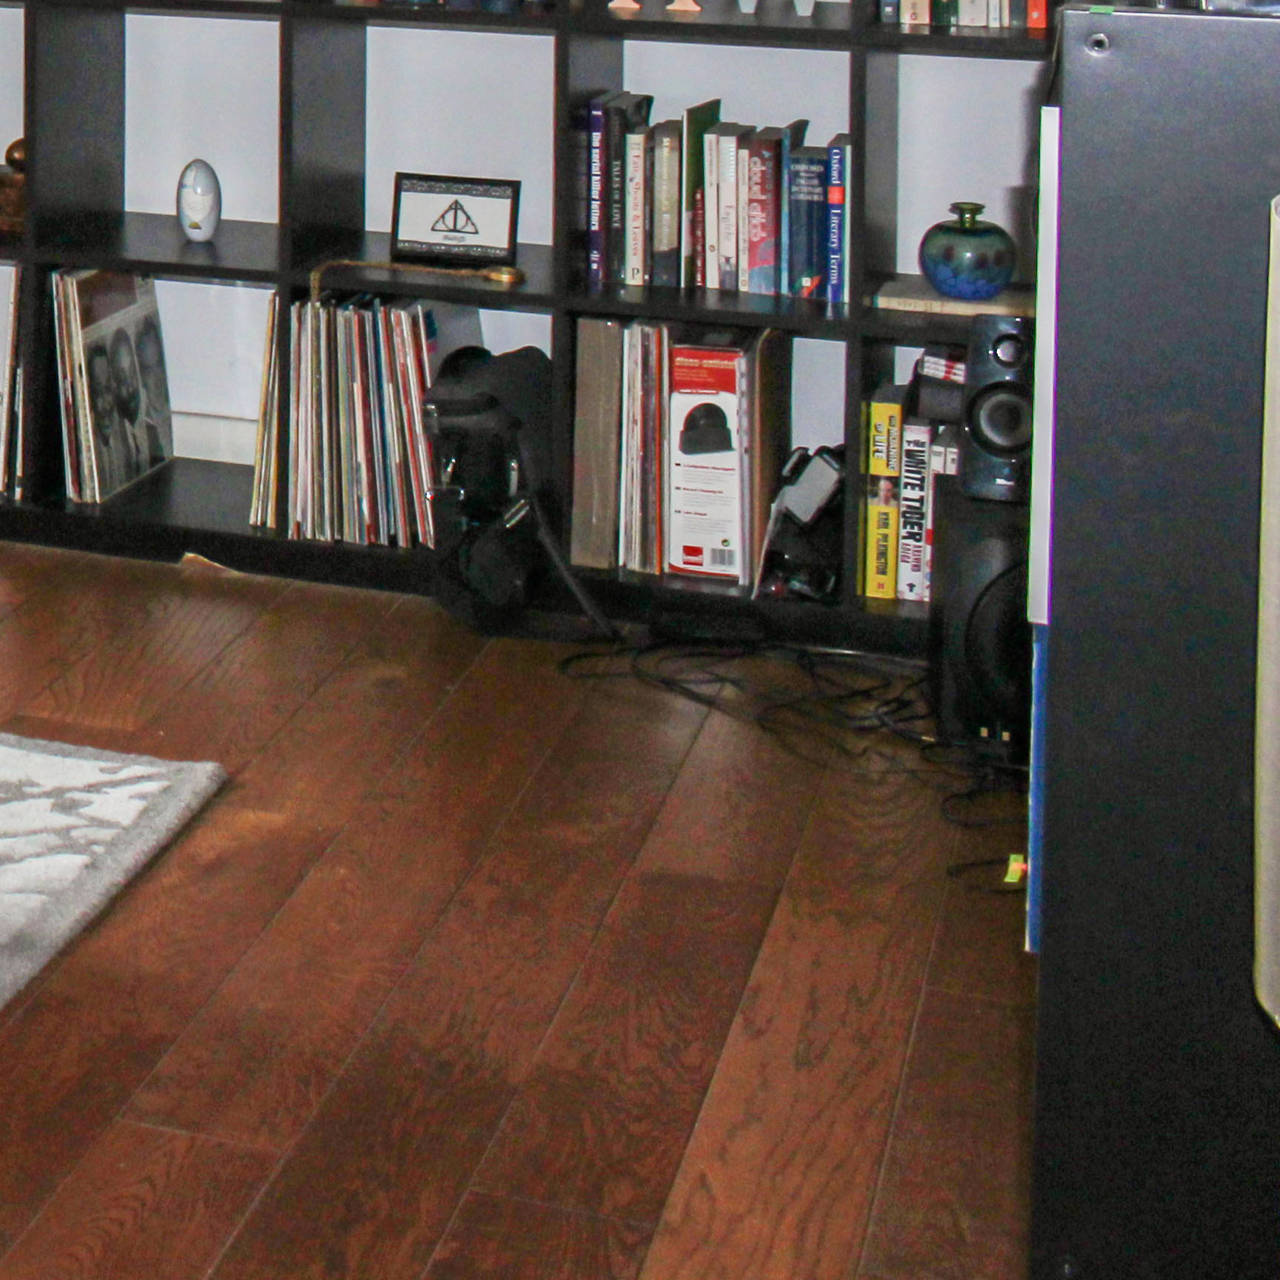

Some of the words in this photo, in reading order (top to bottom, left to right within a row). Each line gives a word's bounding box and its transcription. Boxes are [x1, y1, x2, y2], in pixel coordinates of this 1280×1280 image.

[590, 148, 602, 175] serial
[612, 160, 621, 188] TALES
[830, 149, 841, 185] Oxford
[590, 176, 602, 200] killer
[749, 157, 767, 200] cloud
[590, 201, 602, 231] letters
[612, 204, 621, 229] LOVE
[828, 208, 841, 250] Literary
[830, 253, 841, 285] Terms
[872, 434, 886, 459] LIFE
[887, 427, 898, 472] MOANING
[901, 449, 927, 492] WHITE
[876, 511, 889, 530] KARL
[901, 496, 927, 544] TIGER
[875, 533, 889, 577] PILKINGTON
